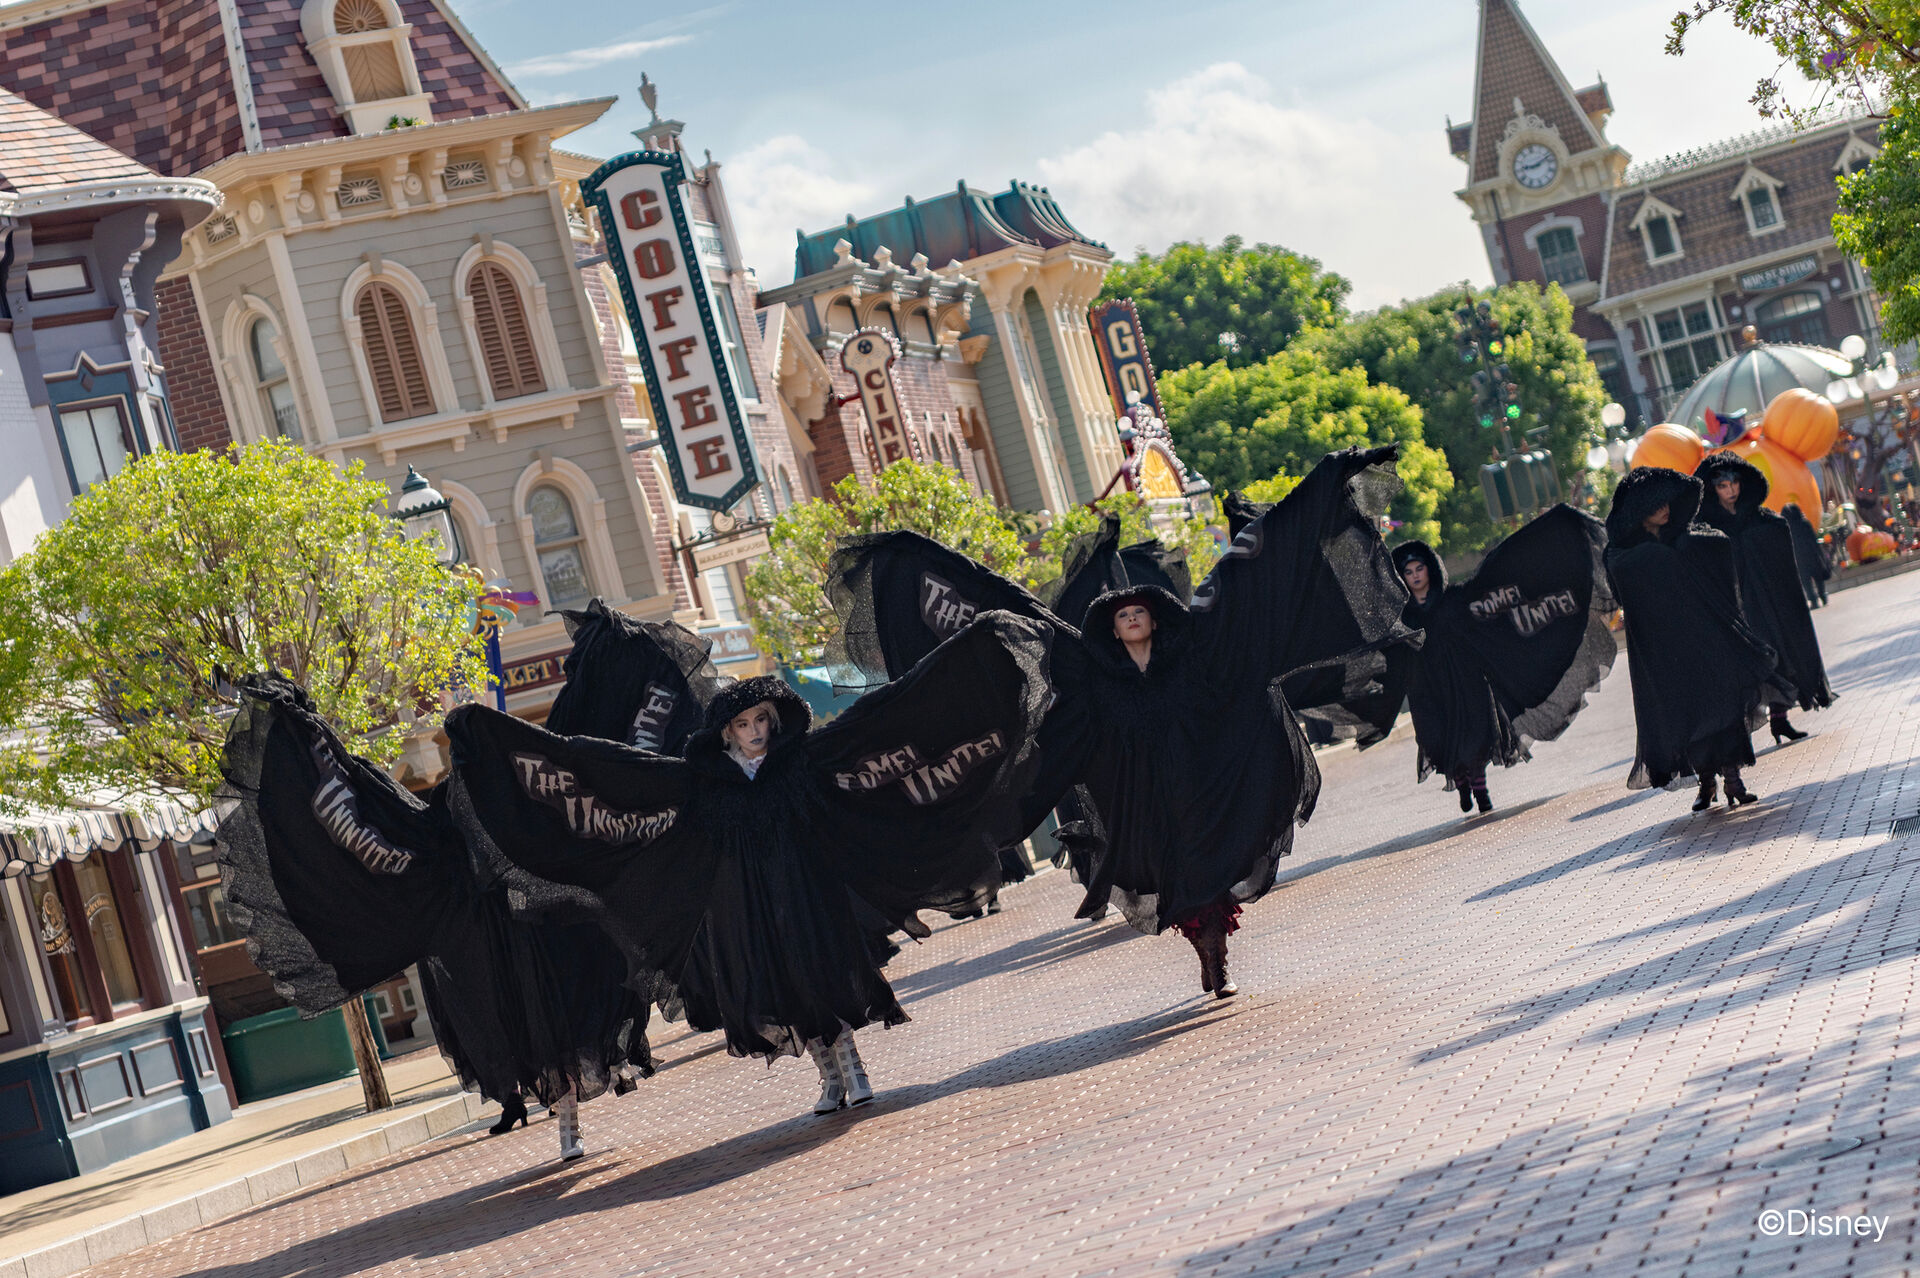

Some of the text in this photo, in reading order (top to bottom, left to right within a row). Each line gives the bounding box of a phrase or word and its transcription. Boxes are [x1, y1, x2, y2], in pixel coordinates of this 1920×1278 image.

[1778, 257, 1817, 276] STATION
[620, 188, 732, 480] COFFEE
[925, 576, 975, 630] THE
[1469, 585, 1521, 616] COME!
[1511, 590, 1576, 633] UNITE!
[504, 659, 552, 688] KET
[632, 686, 677, 750] NITE!
[515, 756, 575, 797] THE
[901, 733, 1001, 804] UNITE!
[314, 774, 413, 874] UNINVITED
[564, 795, 677, 841] UNINVITED
